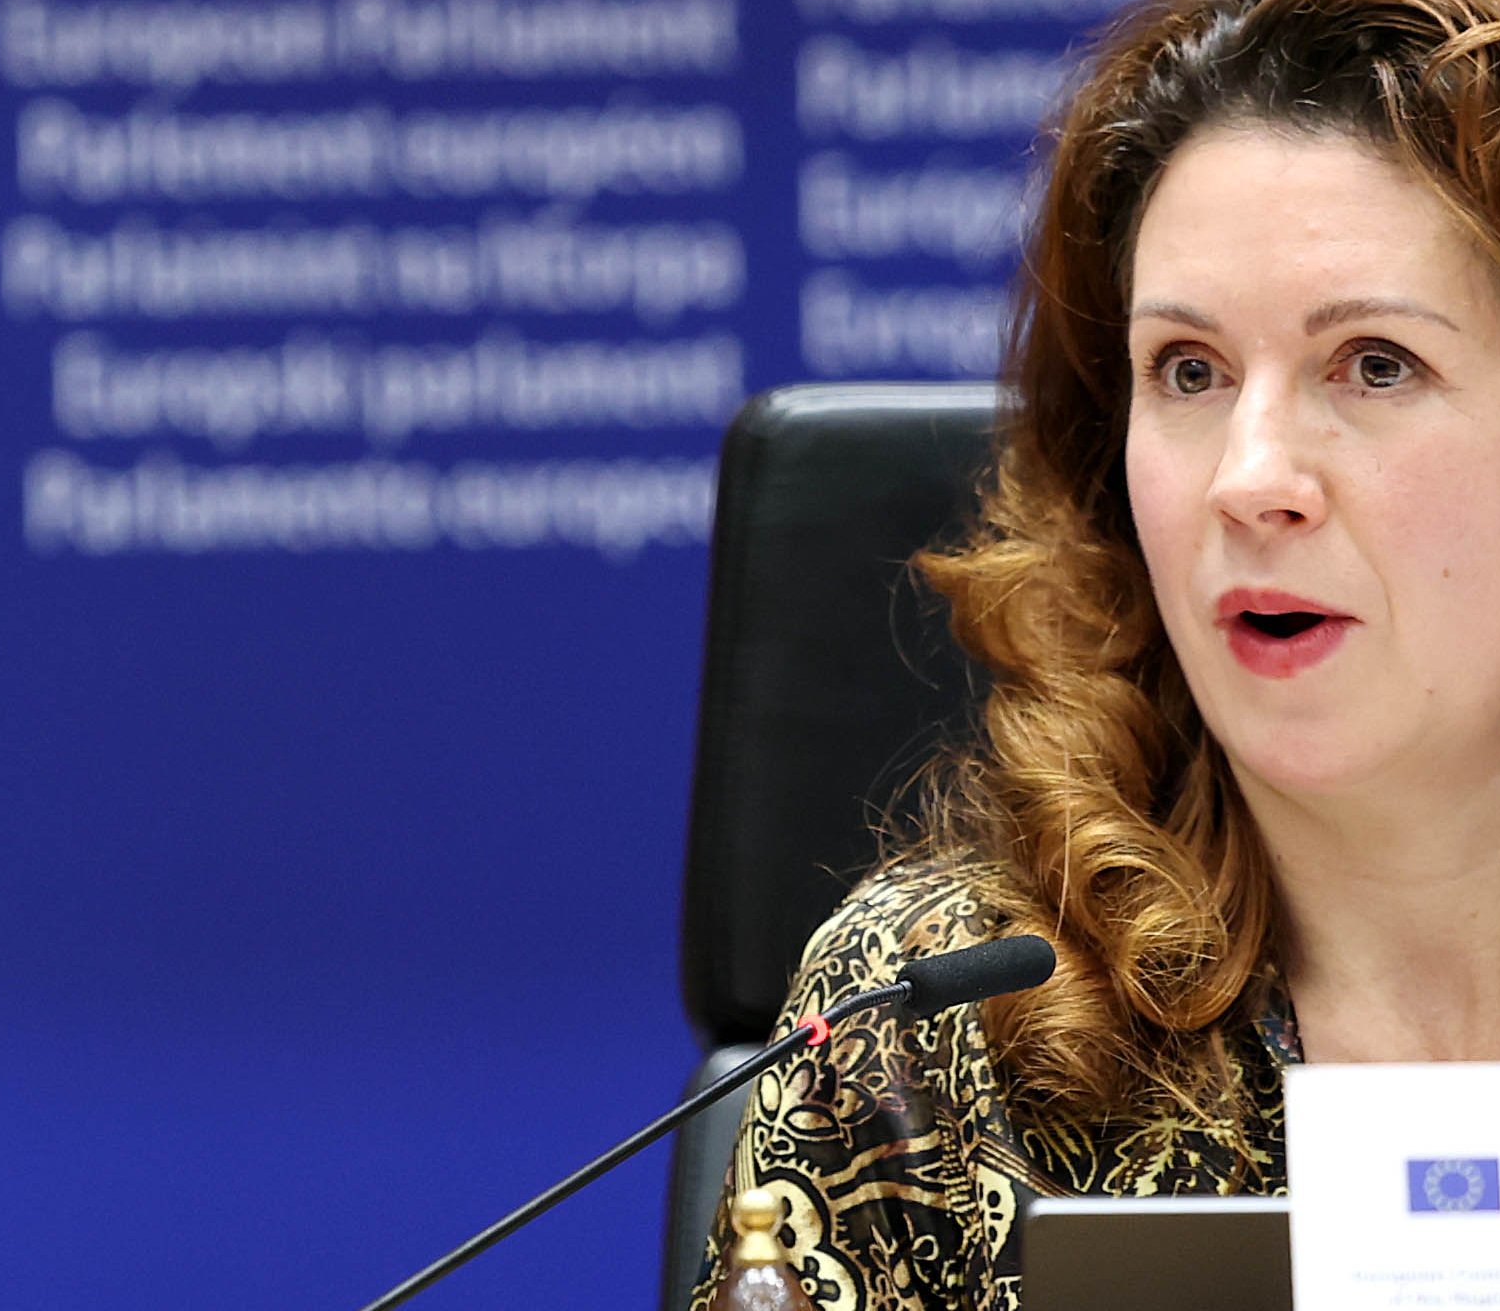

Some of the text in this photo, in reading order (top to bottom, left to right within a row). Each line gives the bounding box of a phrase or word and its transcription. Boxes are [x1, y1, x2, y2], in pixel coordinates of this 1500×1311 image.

[805, 35, 1051, 136] Parlam
[23, 92, 738, 211] Parlement européen
[384, 231, 481, 308] na
[484, 210, 739, 325] hEorpa
[808, 153, 1021, 268] Európ
[810, 275, 1008, 379] Evrop
[59, 327, 742, 448] Europski parlament
[31, 450, 442, 551] Parlamento
